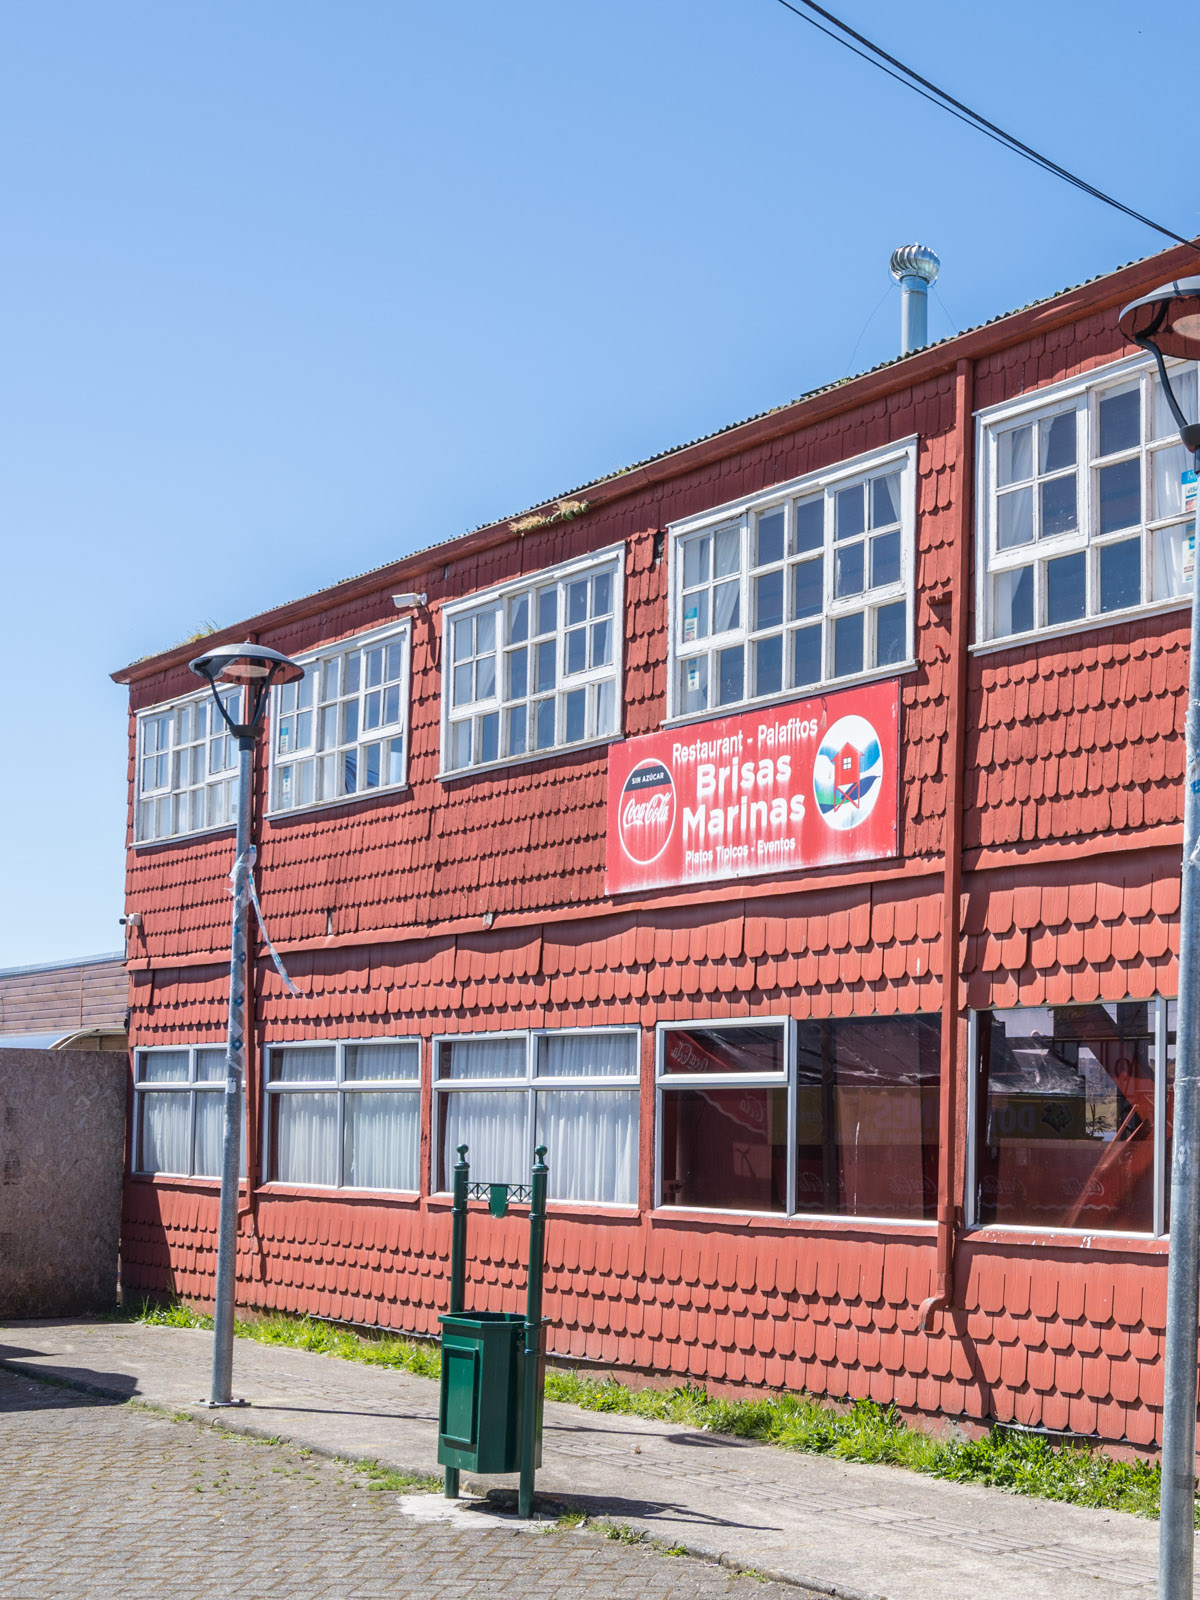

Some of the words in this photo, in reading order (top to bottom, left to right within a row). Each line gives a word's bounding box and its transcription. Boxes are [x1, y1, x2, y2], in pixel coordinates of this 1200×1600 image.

[672, 729, 743, 764] Restaurant
[757, 717, 818, 749] Palafitos
[631, 777, 641, 785] SIN
[642, 772, 665, 783] AZÚCAR
[696, 754, 792, 797] Brisas
[622, 792, 673, 828] Coca-Cola
[682, 794, 806, 841] Marinas
[685, 849, 713, 866] Platos
[715, 843, 748, 861] Típicos
[757, 837, 796, 855] Eventos
